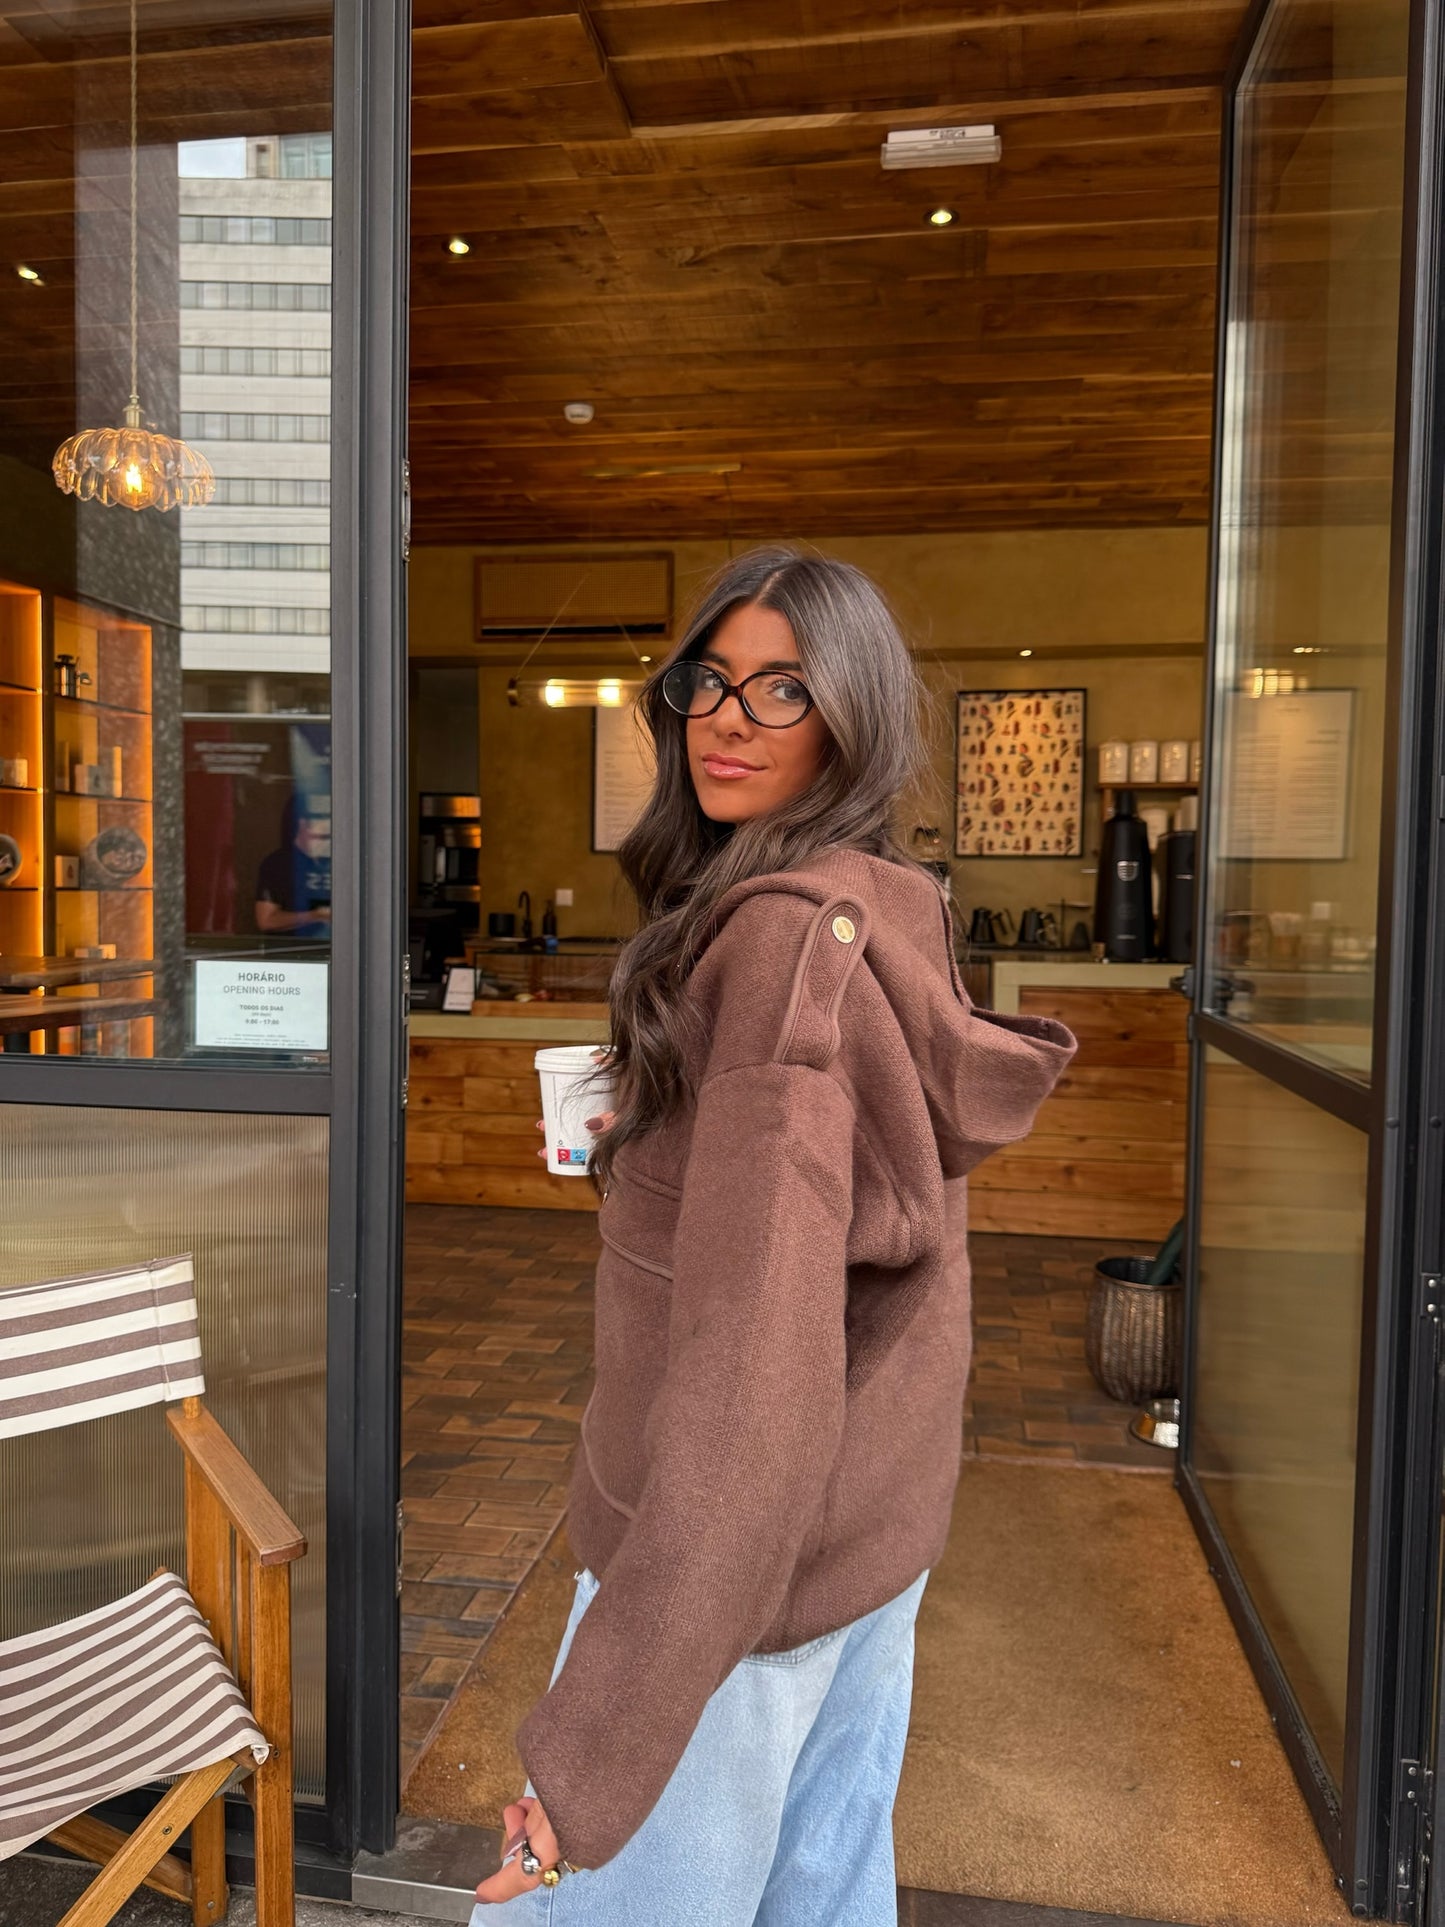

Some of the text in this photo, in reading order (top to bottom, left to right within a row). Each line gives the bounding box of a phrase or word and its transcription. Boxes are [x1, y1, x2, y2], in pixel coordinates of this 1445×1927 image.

[238, 971, 286, 982] HORÁRIO
[223, 985, 301, 996] OPENING HOURS
